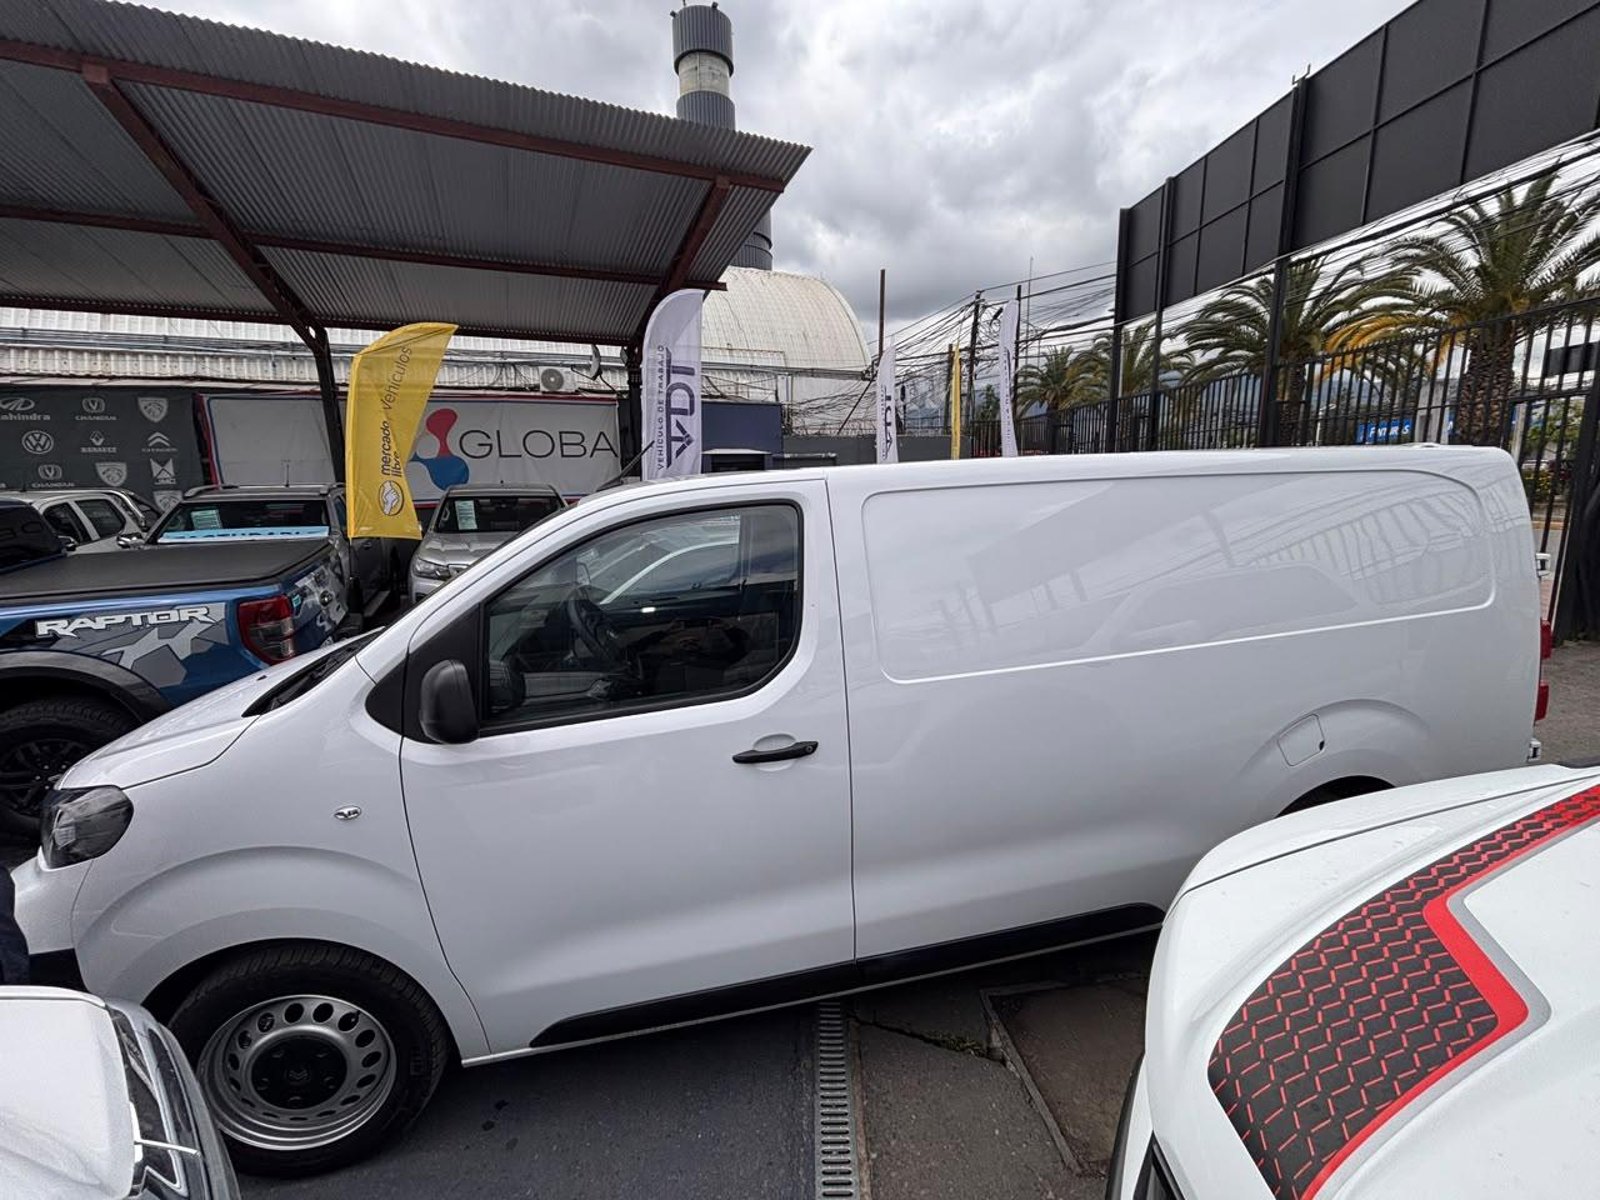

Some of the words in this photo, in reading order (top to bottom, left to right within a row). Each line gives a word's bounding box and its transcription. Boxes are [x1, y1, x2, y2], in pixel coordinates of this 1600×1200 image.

[657, 344, 665, 395] TRABAJO
[657, 399, 665, 413] DE
[381, 420, 391, 476] mercado
[459, 429, 618, 459] GLOBA
[36, 607, 217, 638] RAPTOR
